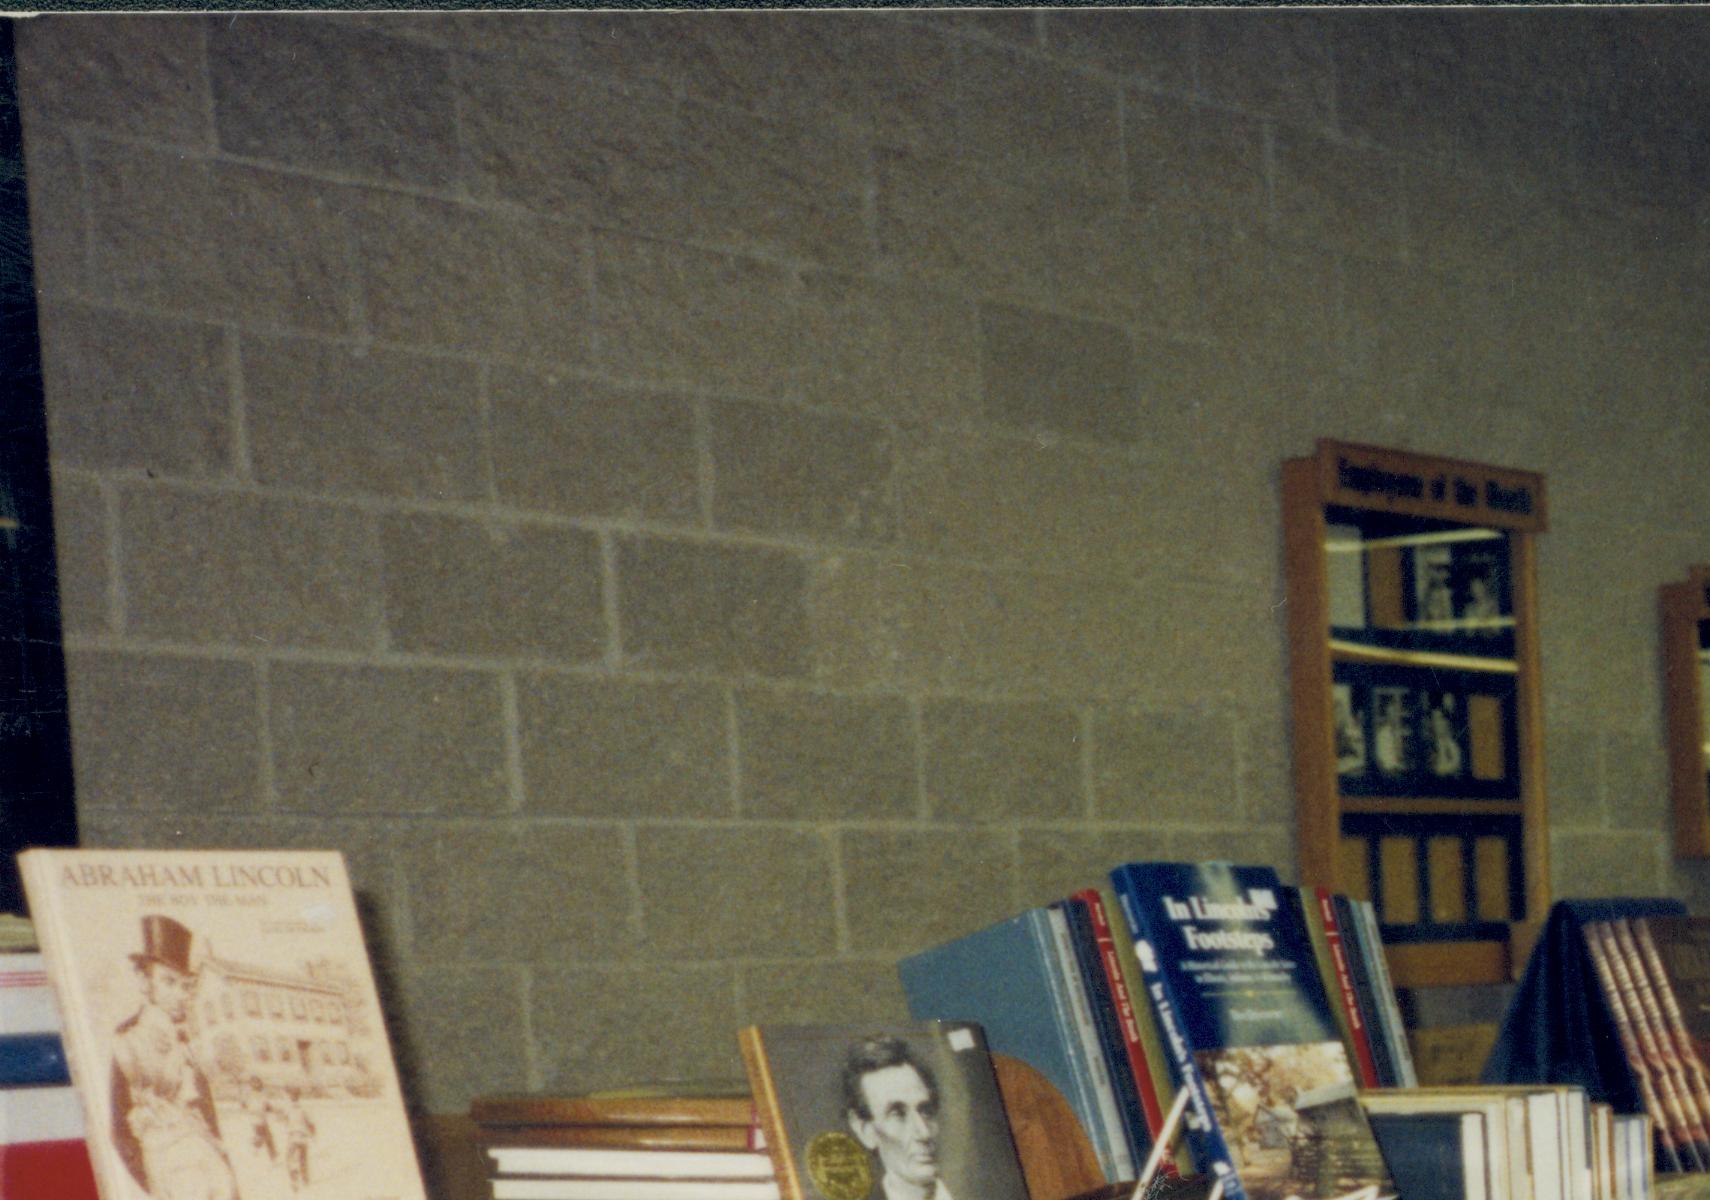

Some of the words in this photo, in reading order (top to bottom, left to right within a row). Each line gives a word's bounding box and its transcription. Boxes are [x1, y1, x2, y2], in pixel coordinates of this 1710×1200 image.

[62, 864, 204, 889] ABRAHAM
[211, 864, 332, 888] LINCOLN
[1162, 896, 1191, 920] In
[1182, 925, 1275, 956] Footsteps
